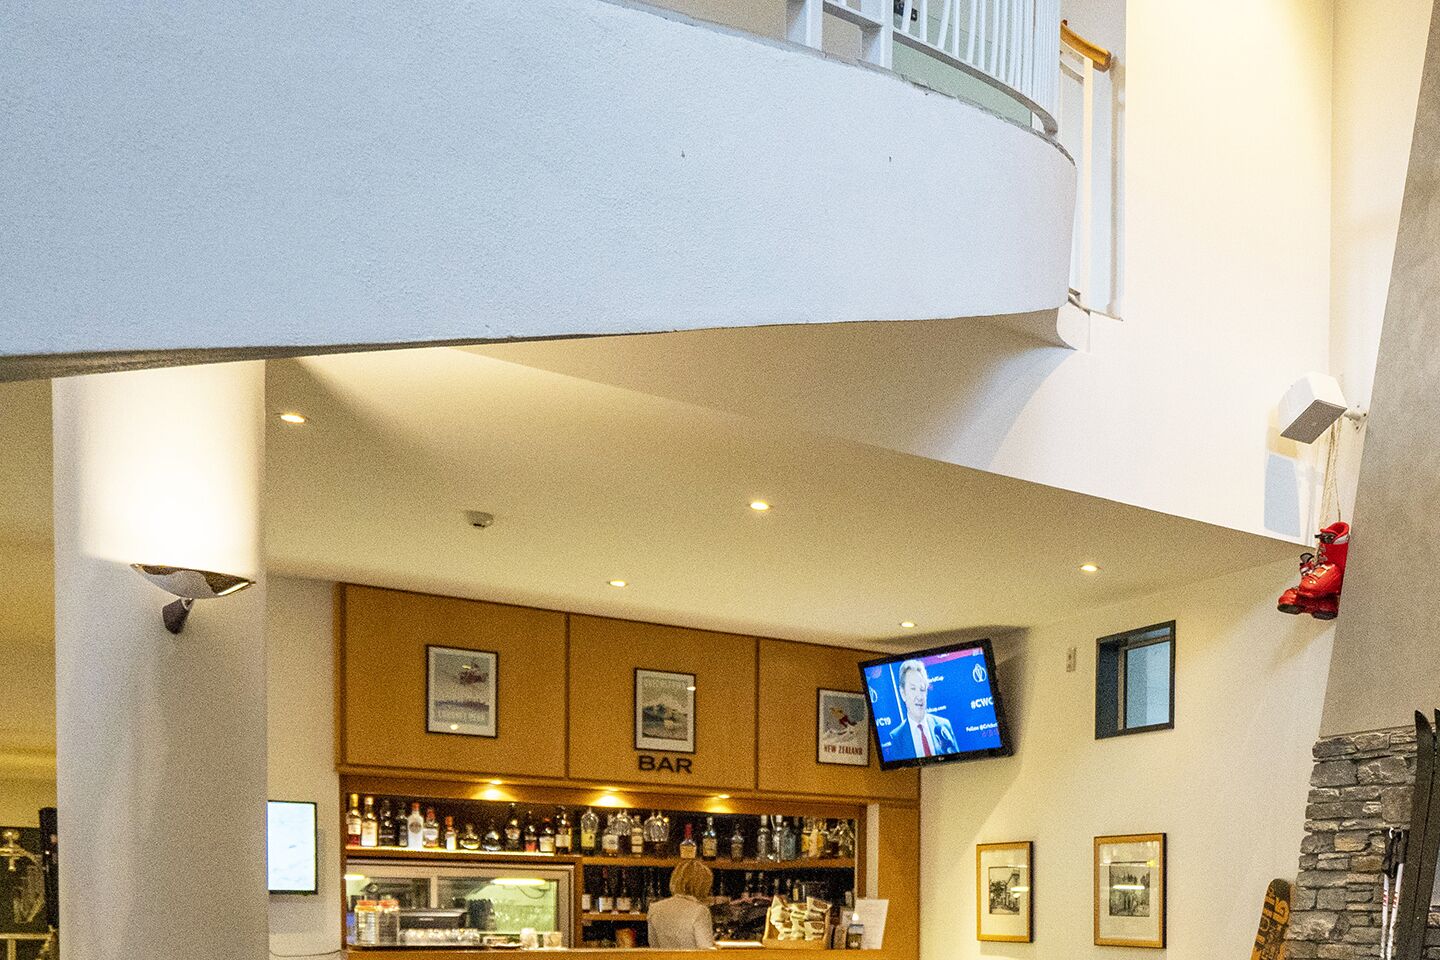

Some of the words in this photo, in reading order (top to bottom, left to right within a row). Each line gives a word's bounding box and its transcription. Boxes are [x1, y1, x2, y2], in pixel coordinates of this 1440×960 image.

[824, 744, 836, 753] NEW
[838, 745, 863, 756] ZEALAND
[638, 755, 693, 774] BAR
